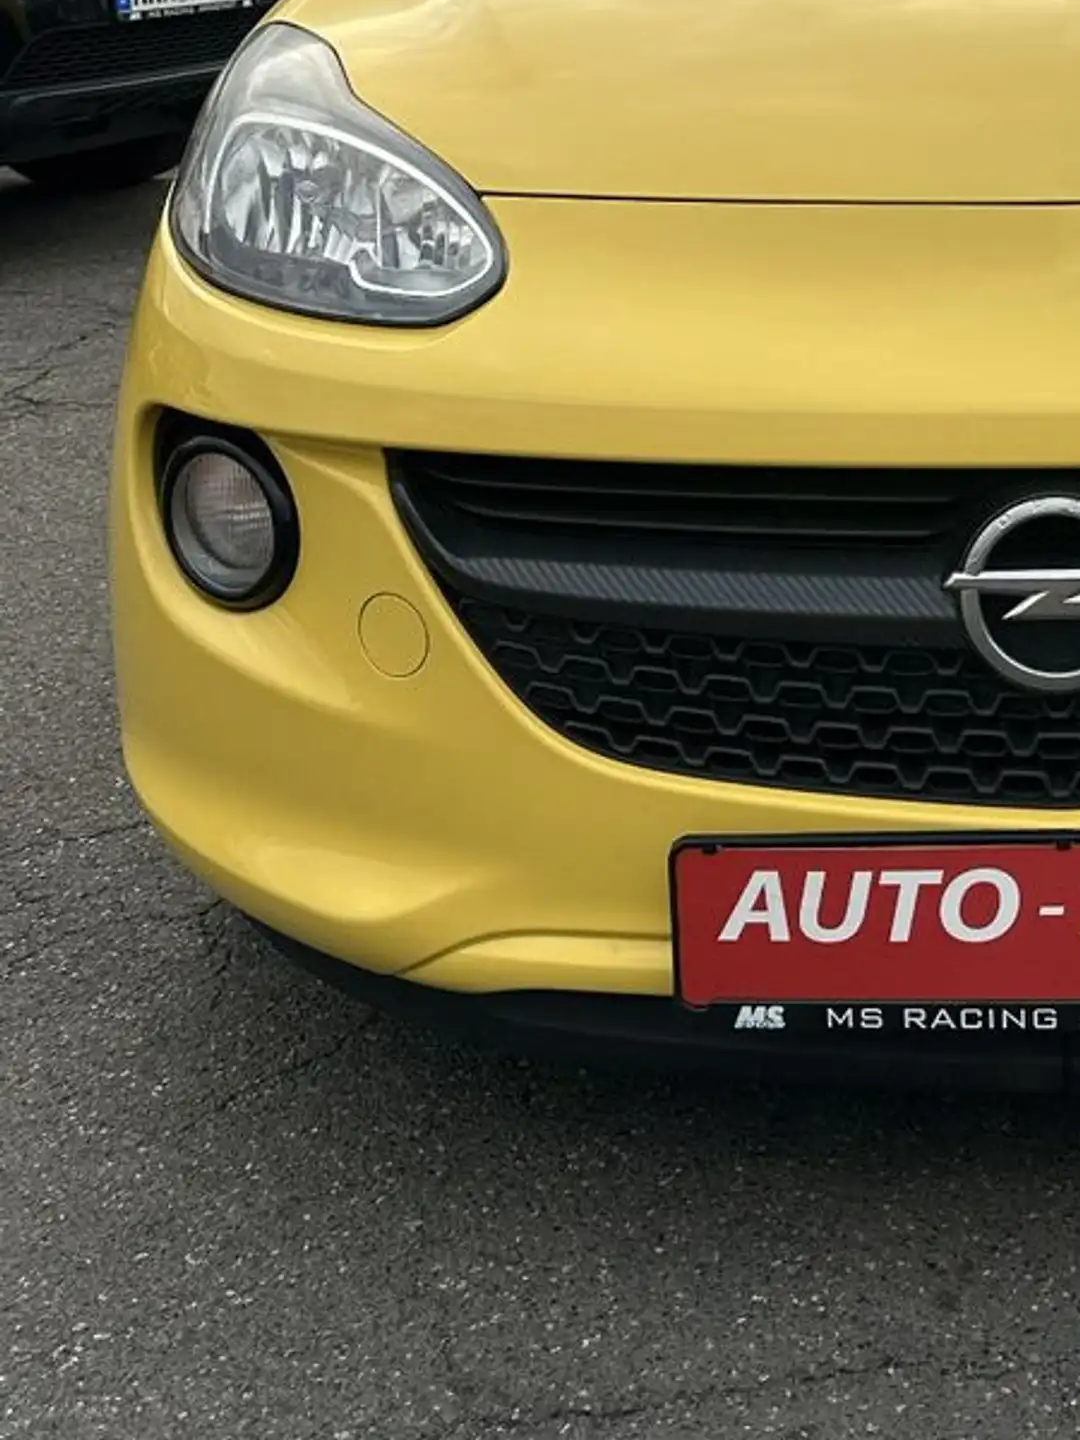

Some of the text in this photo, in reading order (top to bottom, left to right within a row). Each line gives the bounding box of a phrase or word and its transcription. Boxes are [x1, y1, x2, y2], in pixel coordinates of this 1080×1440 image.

[718, 868, 1021, 943] AUTO
[734, 1005, 786, 1030] MS
[826, 1007, 884, 1029] MS
[904, 1007, 1058, 1030] RACING
